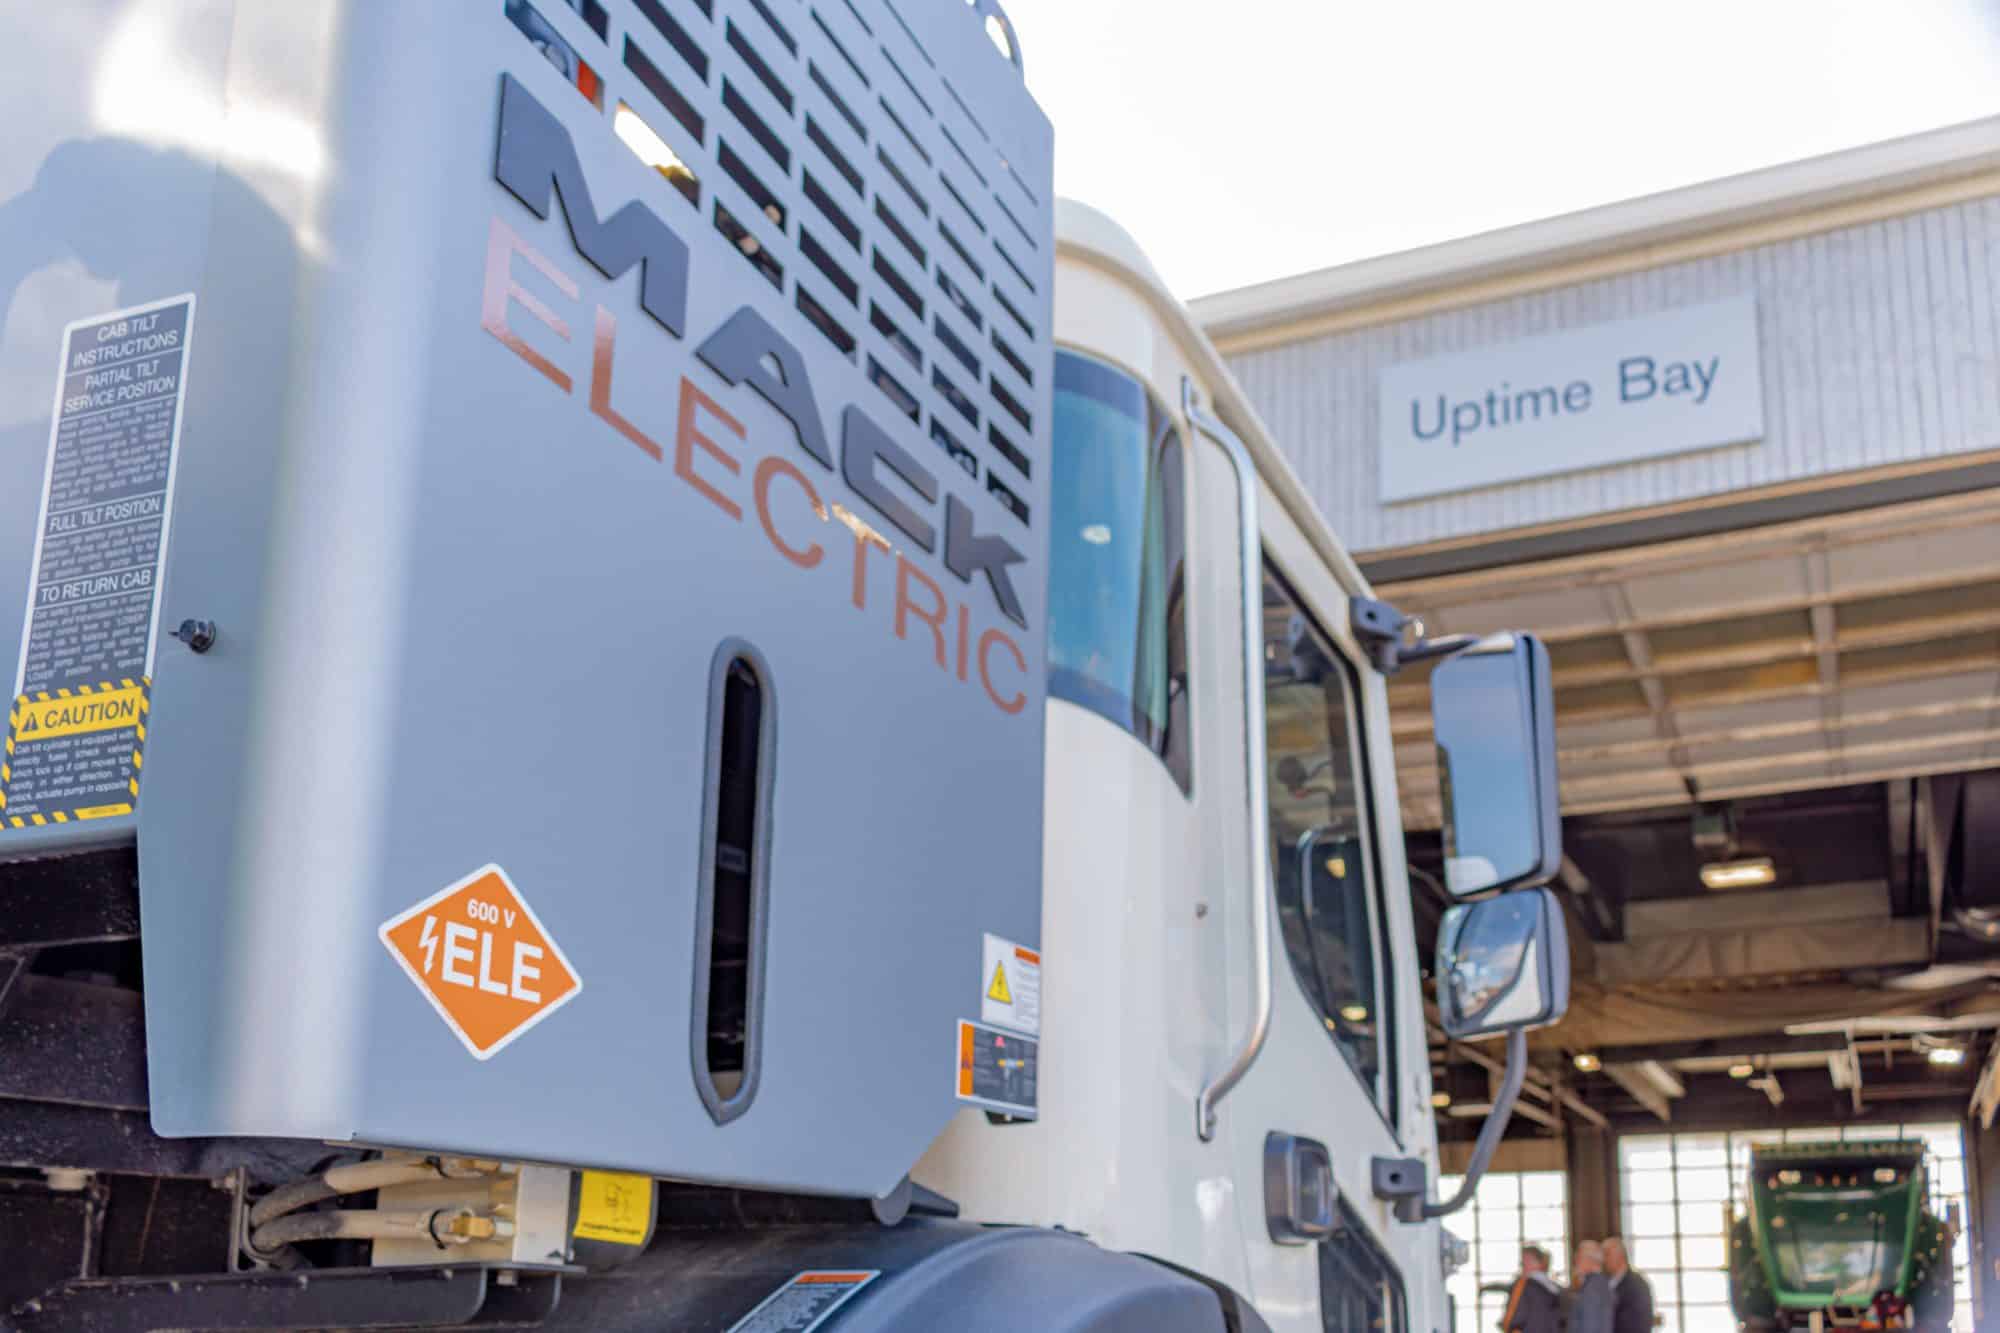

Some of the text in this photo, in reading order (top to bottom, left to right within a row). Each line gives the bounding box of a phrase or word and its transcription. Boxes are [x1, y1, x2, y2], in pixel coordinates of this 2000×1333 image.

[97, 314, 160, 342] CAB TILT
[73, 330, 177, 368] INSTRUCTIONS
[494, 71, 1029, 630] MACK
[85, 359, 161, 390] PARTIAL TILT
[64, 375, 176, 413] SERVICE POSITION
[1411, 355, 1720, 447] Uptime Bay
[481, 216, 1028, 715] ELECTRIC
[49, 496, 160, 532] FULL TILT POSITION
[41, 569, 152, 602] TO RETURN CAB
[44, 698, 135, 729] CAUTION
[467, 898, 516, 929] 600 V
[441, 920, 544, 1004] ELE
